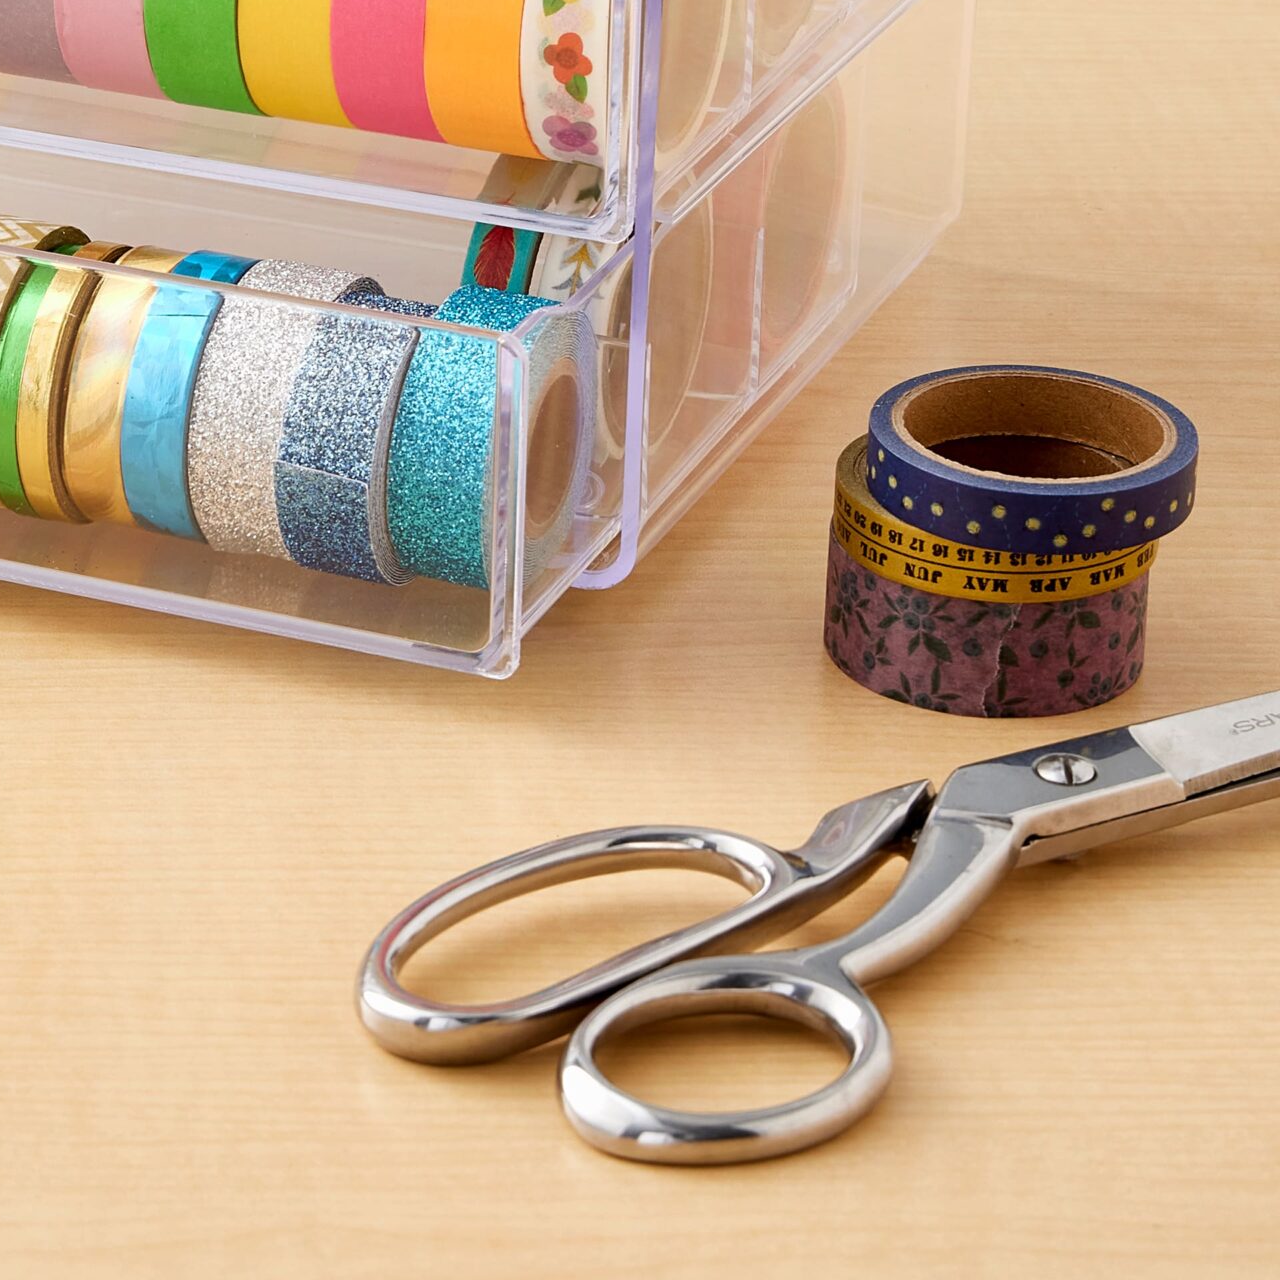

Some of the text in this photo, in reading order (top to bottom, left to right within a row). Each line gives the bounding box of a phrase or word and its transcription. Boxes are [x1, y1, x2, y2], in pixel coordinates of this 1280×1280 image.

[854, 510, 867, 529] 20
[870, 521, 883, 537] 19
[888, 529, 903, 546] 18
[909, 537, 925, 553] 17
[860, 541, 888, 567] JUL
[932, 543, 949, 558] 16
[957, 548, 975, 562] 15
[983, 550, 1001, 565] 14
[1009, 552, 1027, 567] 13
[903, 562, 943, 584] JUN
[1089, 563, 1126, 585] MAR
[962, 575, 1009, 593] MAY
[1029, 577, 1072, 593] APR
